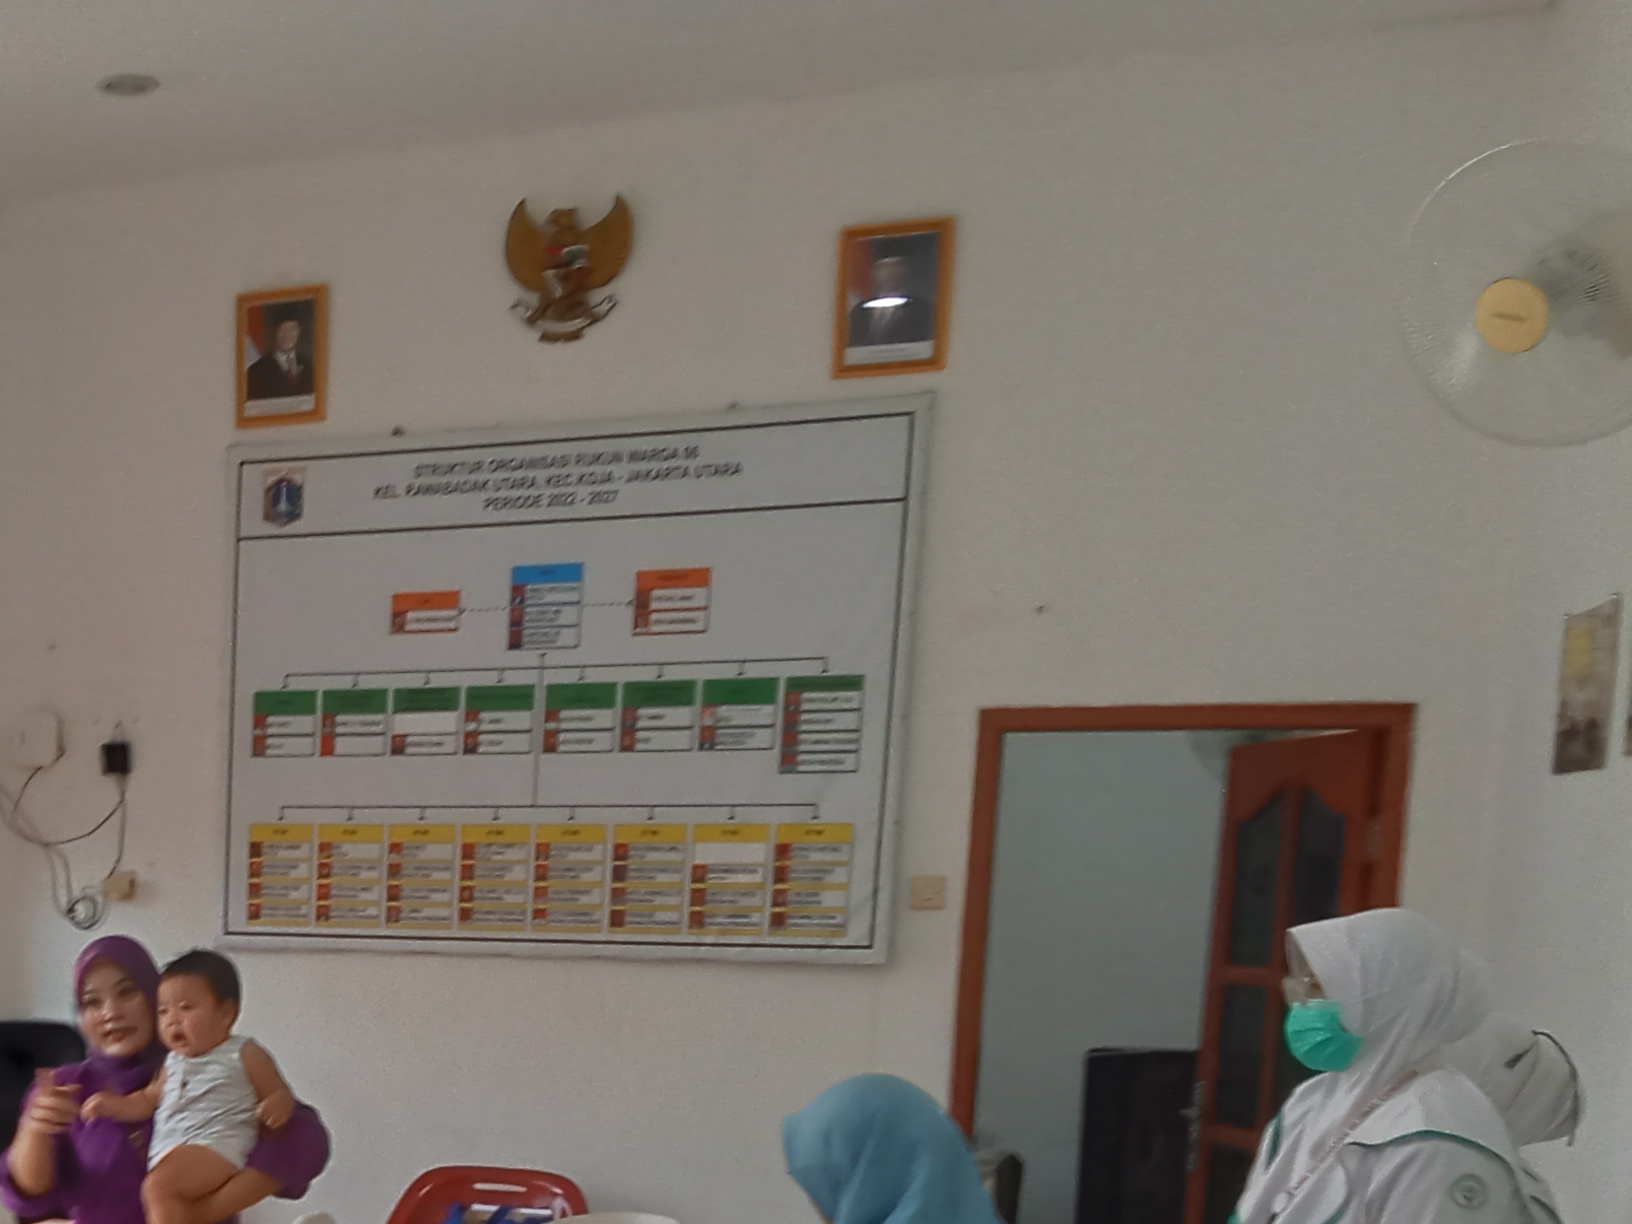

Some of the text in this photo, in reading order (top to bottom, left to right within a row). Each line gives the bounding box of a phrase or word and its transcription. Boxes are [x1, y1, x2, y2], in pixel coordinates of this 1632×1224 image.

[414, 459, 484, 479] STRUKTUR
[486, 453, 570, 473] ORGANISASI
[574, 450, 624, 467] RUKUN
[627, 446, 679, 463] WARGA
[624, 464, 690, 483] JAKARTA
[692, 461, 743, 479] UTARA
[483, 493, 544, 511] PERIODE
